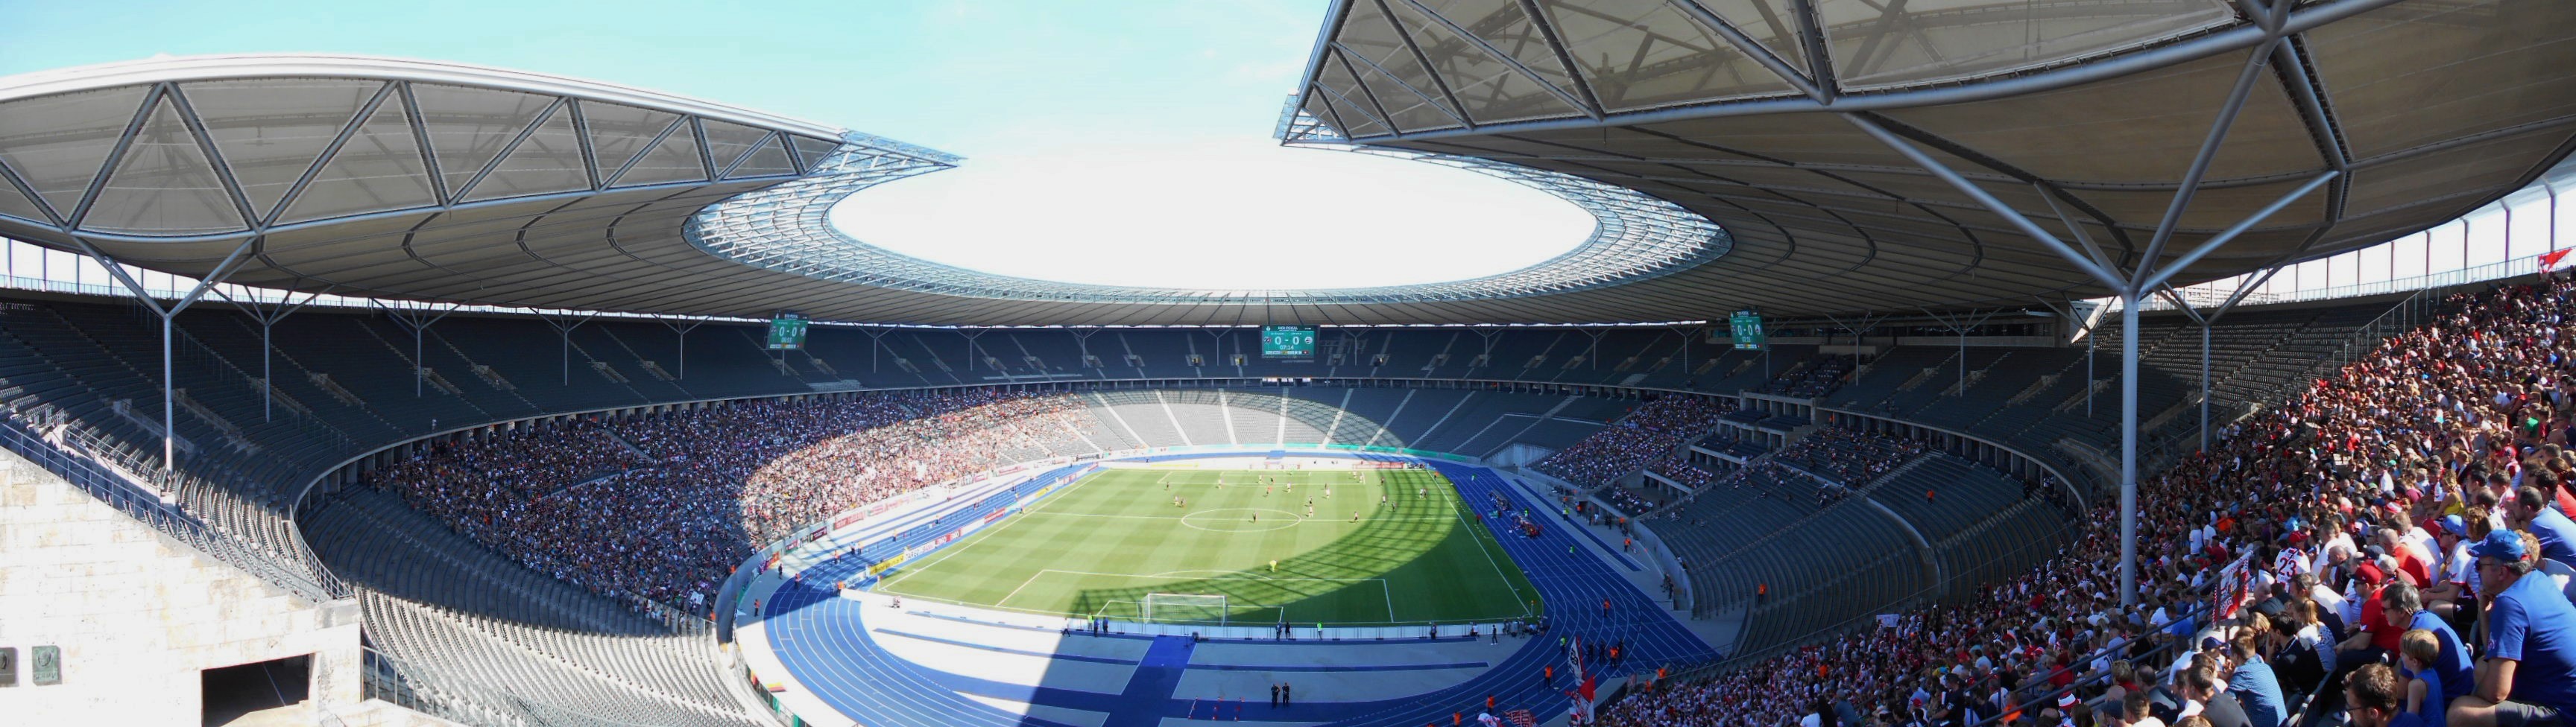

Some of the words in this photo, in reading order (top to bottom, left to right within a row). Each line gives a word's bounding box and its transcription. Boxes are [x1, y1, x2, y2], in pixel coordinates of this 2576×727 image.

[1275, 336, 1281, 345] 0
[1292, 336, 1300, 345] 0
[2278, 557, 2298, 577] 23
